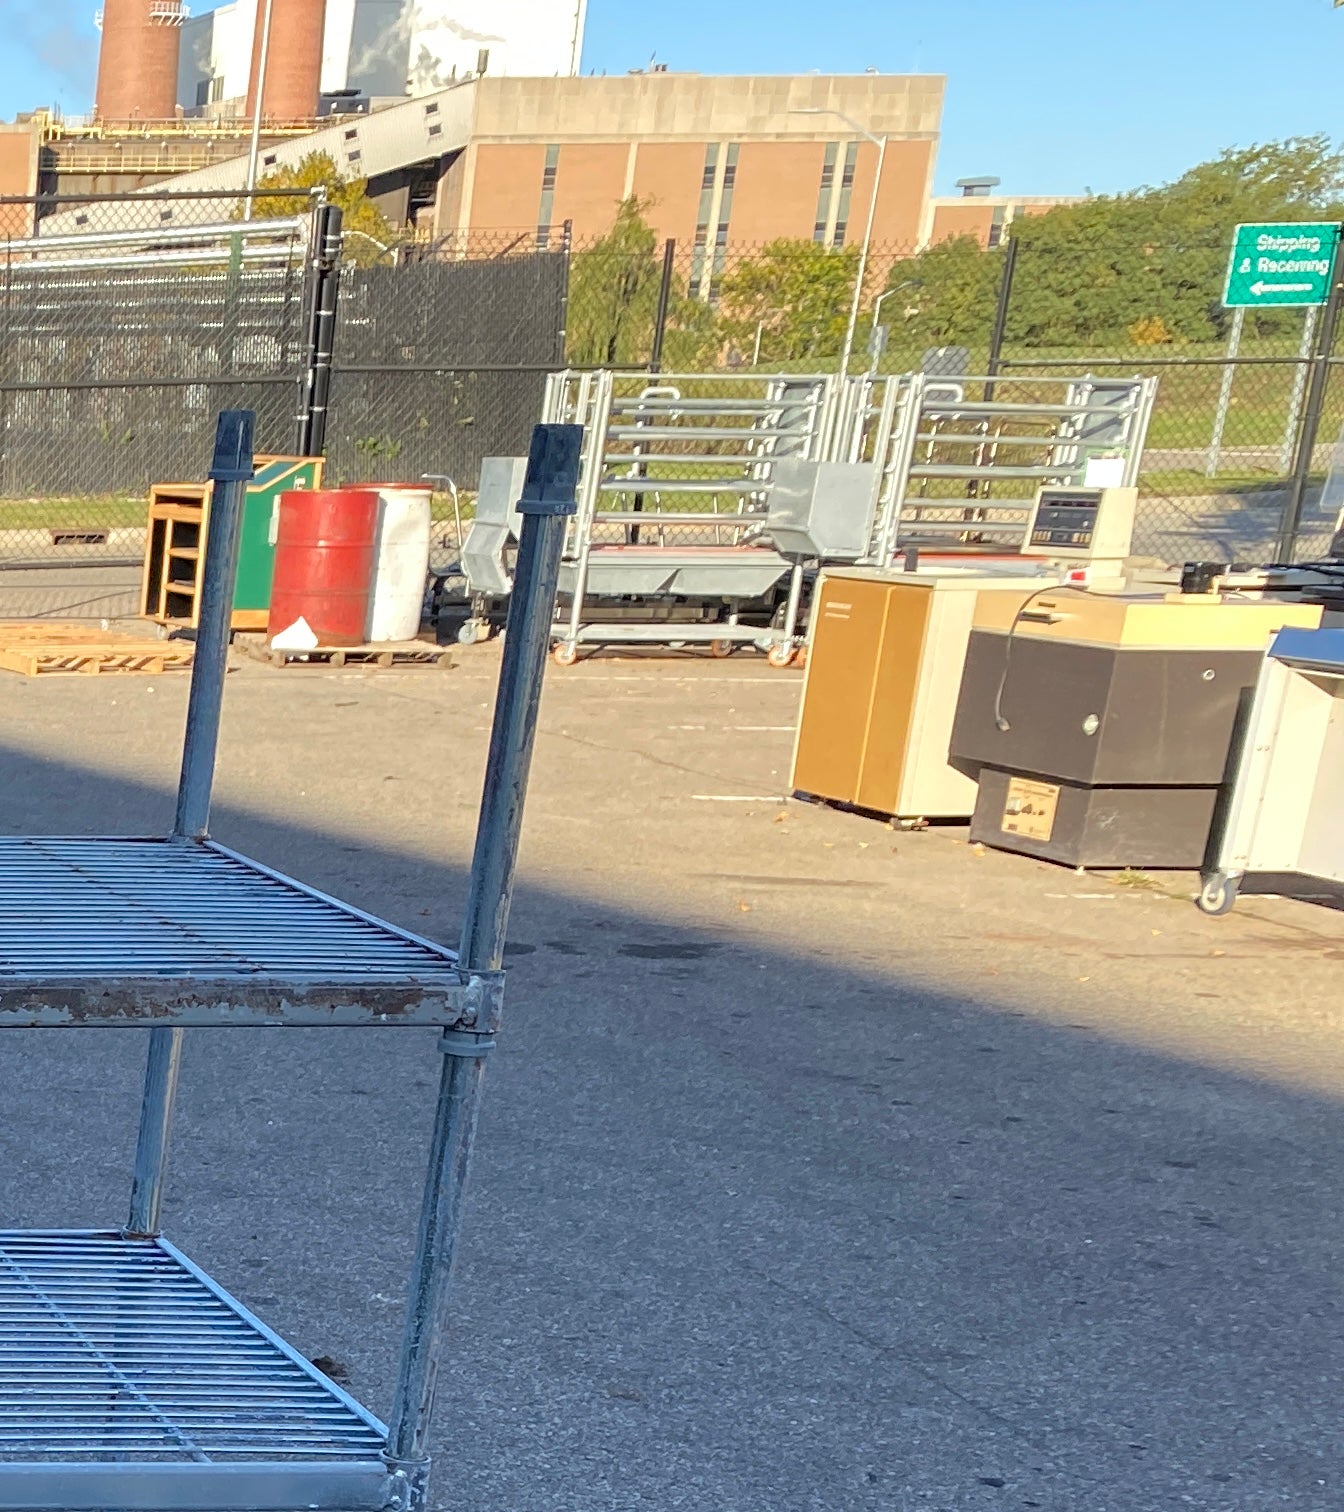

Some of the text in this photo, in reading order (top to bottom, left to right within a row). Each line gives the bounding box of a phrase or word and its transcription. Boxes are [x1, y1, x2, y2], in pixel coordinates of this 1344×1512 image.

[1257, 235, 1320, 252] Shipping
[1239, 258, 1330, 275] & Receiving
